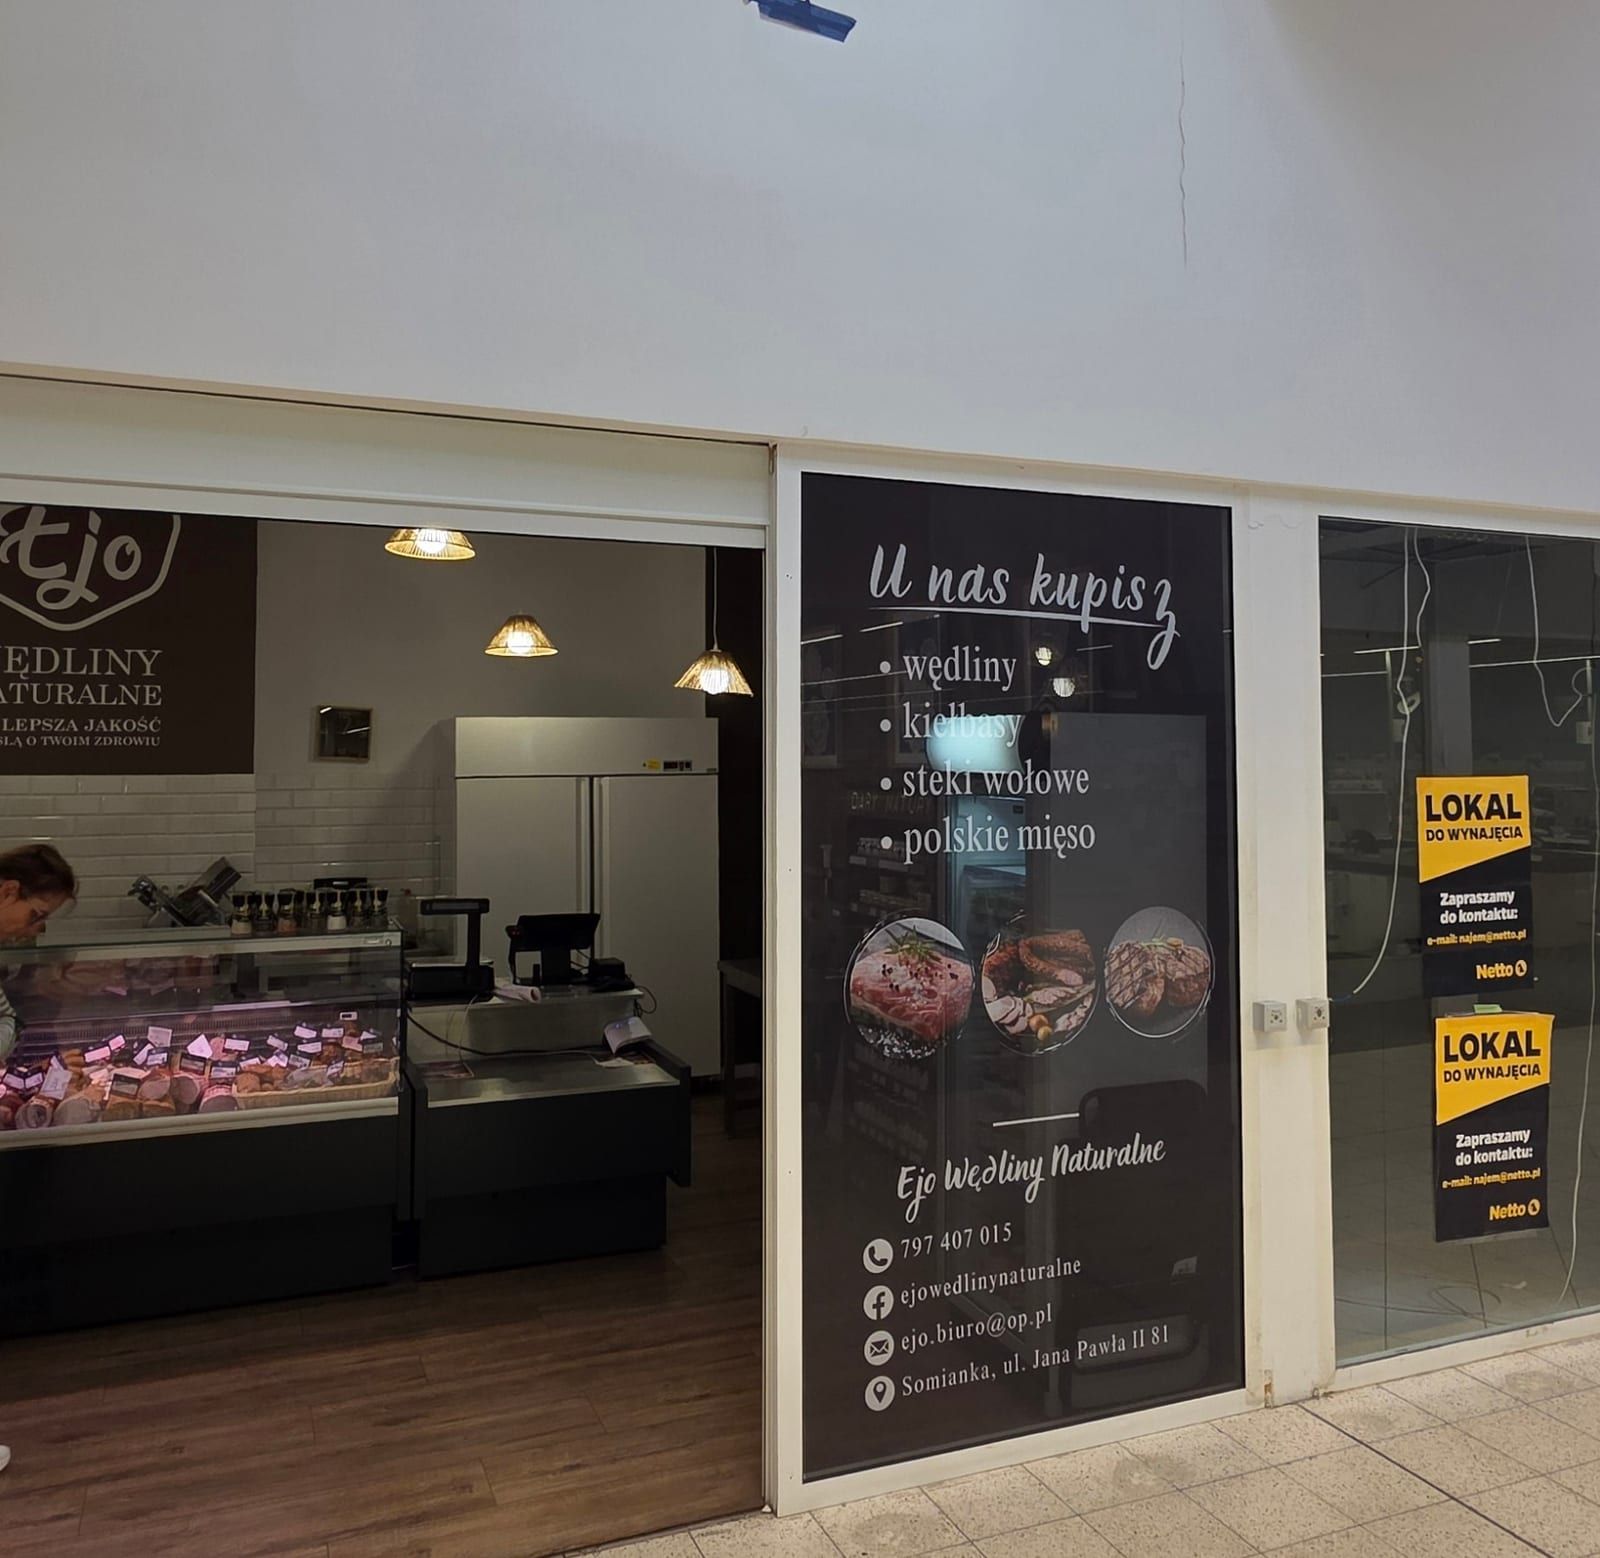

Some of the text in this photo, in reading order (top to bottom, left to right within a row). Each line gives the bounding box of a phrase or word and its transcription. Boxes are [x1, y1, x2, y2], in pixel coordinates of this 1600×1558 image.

[869, 544, 1181, 670] U nas kupisz
[0, 646, 163, 679] ĘDLINY
[903, 646, 1017, 691] wędliny
[0, 682, 162, 706] TURALNE
[84, 717, 162, 733] JAKOŚĆ
[903, 702, 1022, 747] kiełbasy
[26, 736, 37, 747] O
[41, 736, 90, 747] TWOIM
[94, 736, 161, 748] ZDROWIU
[903, 759, 1089, 797] steki wołowe
[1425, 793, 1521, 822] LOKAL
[903, 814, 1096, 865] polskie mięso
[1426, 826, 1523, 842] DO WYNAJĘCIA
[1440, 890, 1515, 908] Zapraszamy
[1440, 907, 1518, 924] do kontaktu:
[1427, 928, 1526, 945] e-mail: najem@netto.pl
[1476, 963, 1513, 979] Netto
[1443, 1030, 1541, 1063] LOKAL
[1444, 1064, 1541, 1083] DO WYNAJĘCIA
[1456, 1129, 1531, 1149] Zapraszamy
[1456, 1147, 1533, 1166] do kontaktu:
[898, 1133, 1166, 1223] Ejo Wędliny Naturalne
[1442, 1168, 1541, 1189] e-mail: najem@netto.pl
[1489, 1203, 1526, 1221] Netto
[900, 1222, 1012, 1259] 797 407 015
[900, 1257, 1081, 1308] ejowedlinynaturalne
[901, 1303, 1053, 1353] ejo.biuro@op.pl
[902, 1324, 1170, 1397] Somianka, ul. Jana Pawła II 81
